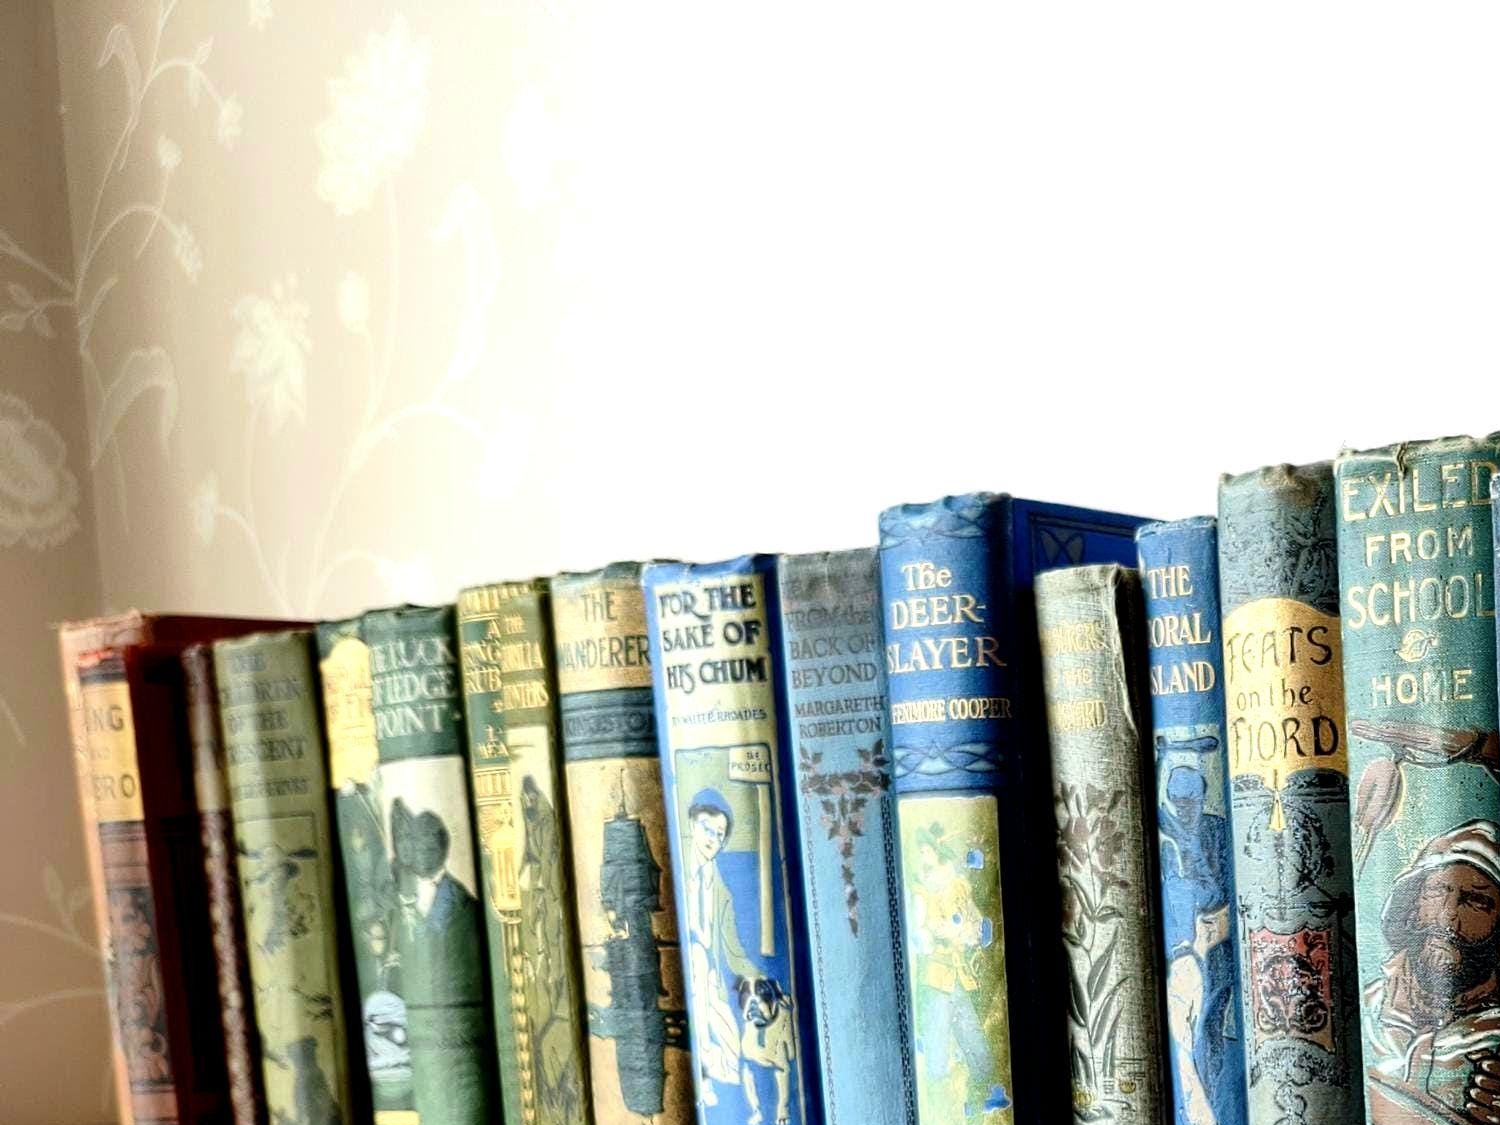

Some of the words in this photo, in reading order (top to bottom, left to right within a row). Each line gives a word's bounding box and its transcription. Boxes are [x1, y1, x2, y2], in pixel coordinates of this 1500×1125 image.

[1342, 461, 1499, 523] EXILED
[1364, 523, 1475, 569] FROM
[901, 559, 953, 592] The
[1148, 565, 1194, 600] THE
[581, 591, 617, 622] THE
[659, 591, 711, 618] FOR
[703, 584, 757, 610] THE
[1346, 572, 1496, 630] SCHOOL
[662, 623, 715, 652] SAKE
[723, 619, 761, 646] OF
[790, 637, 842, 660] BACK
[847, 632, 876, 655] OF
[1151, 612, 1212, 648] ORAL
[887, 635, 1007, 675] SLAYER
[1226, 624, 1333, 684] FEATS
[667, 663, 696, 694] HIS
[699, 656, 769, 685] CHUM
[791, 662, 877, 690] BEYOND
[1151, 661, 1216, 696] SLAND
[1369, 668, 1474, 710] HOME
[949, 696, 1013, 721] COOPER
[1236, 689, 1261, 713] on
